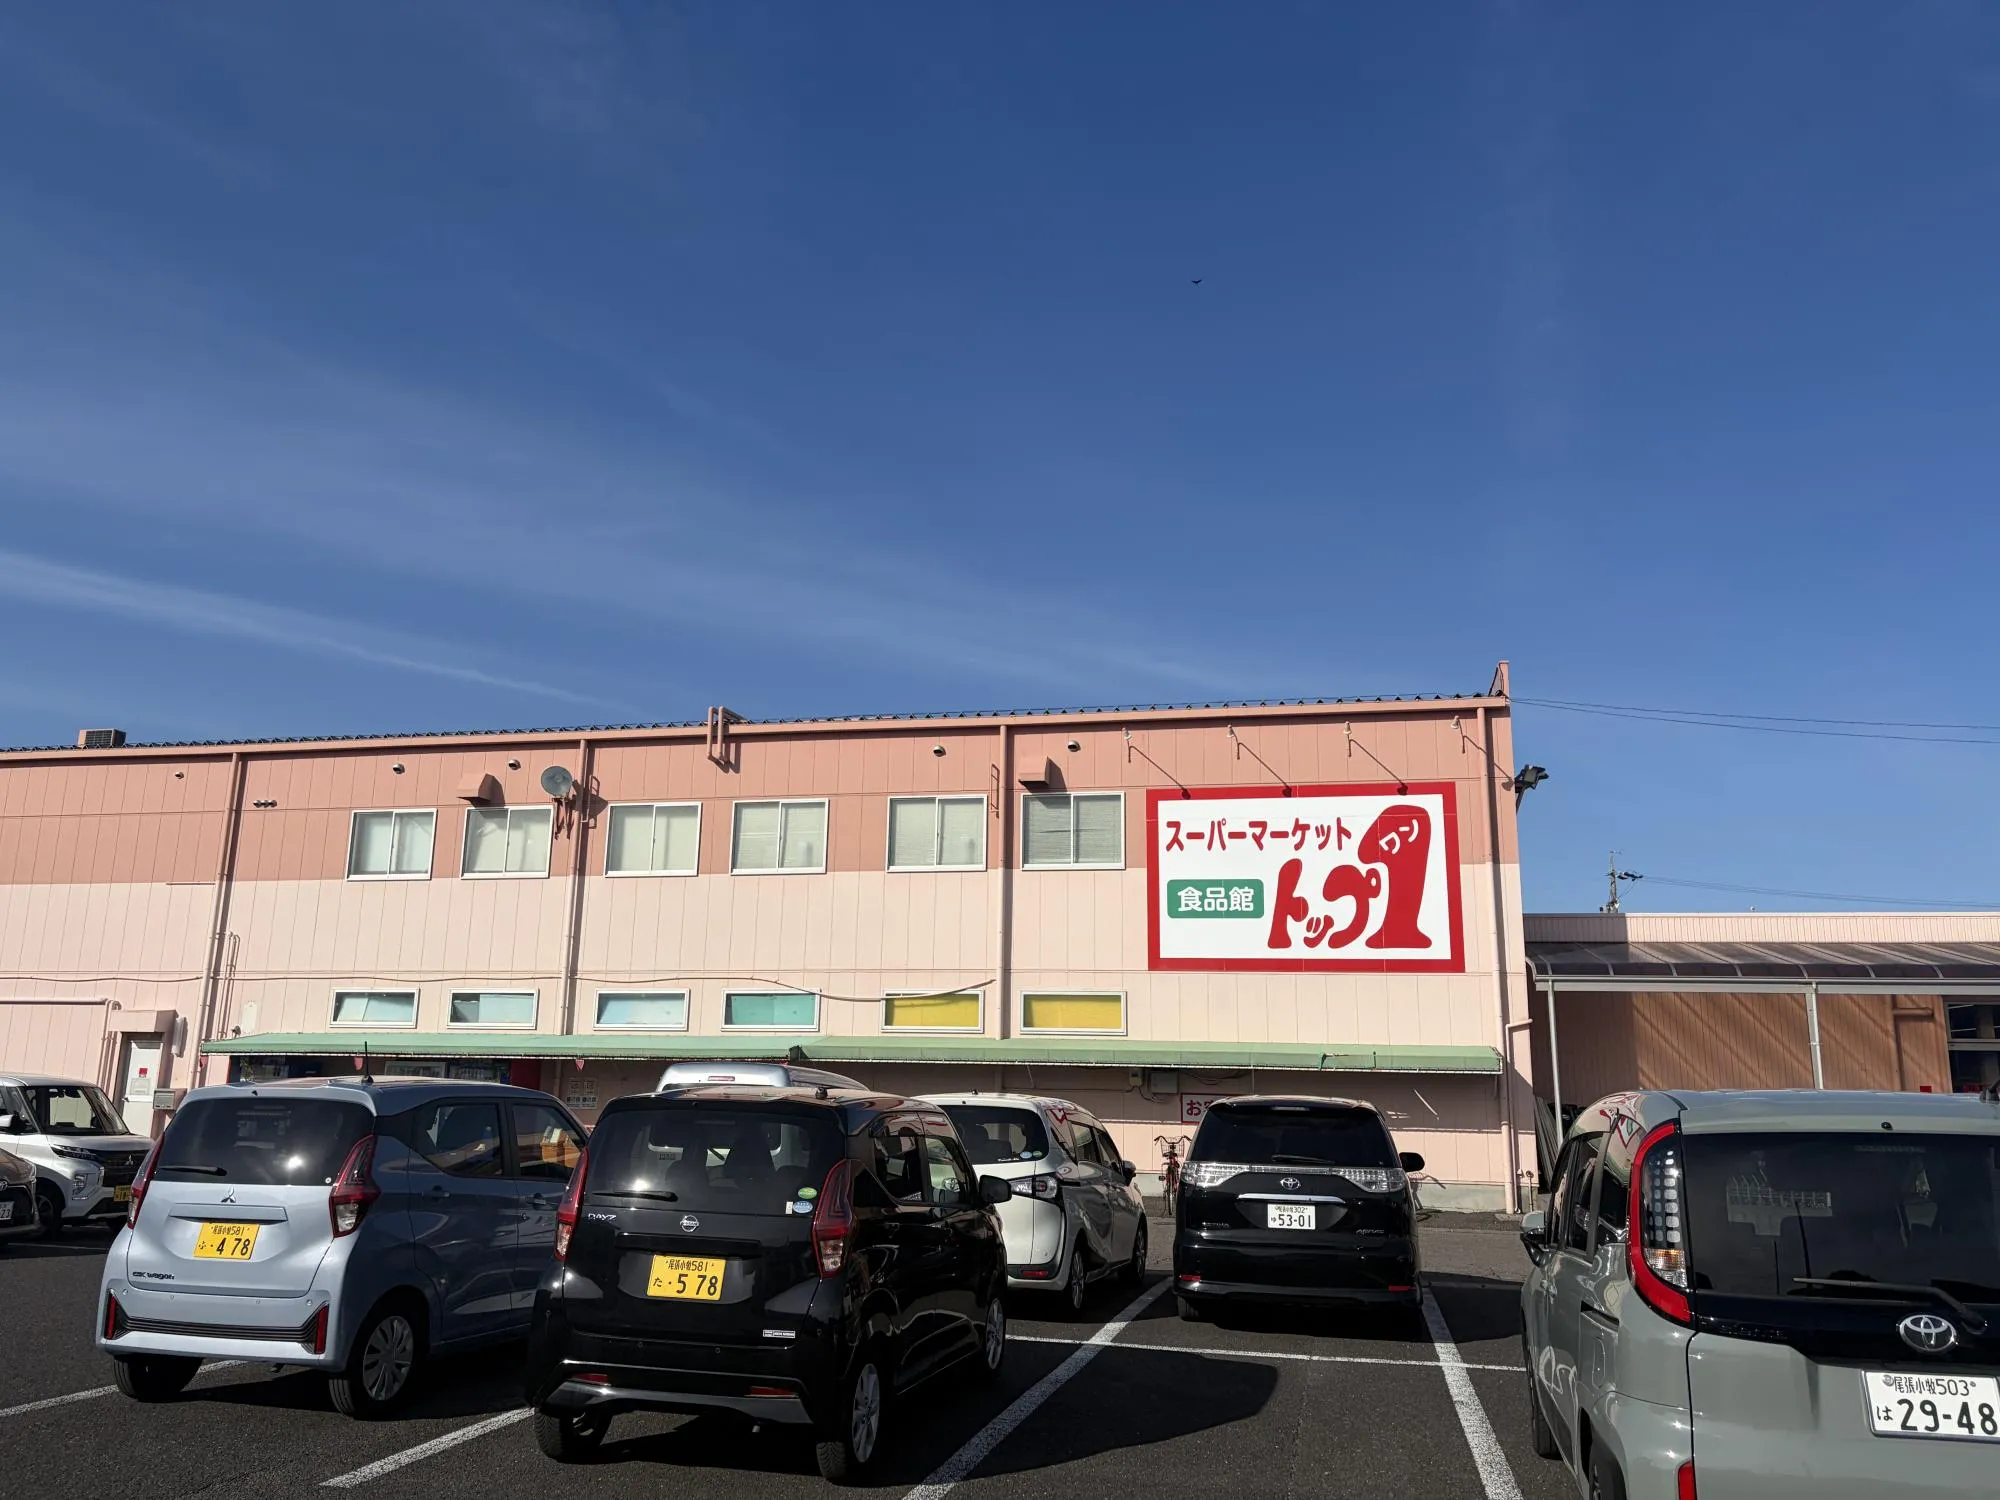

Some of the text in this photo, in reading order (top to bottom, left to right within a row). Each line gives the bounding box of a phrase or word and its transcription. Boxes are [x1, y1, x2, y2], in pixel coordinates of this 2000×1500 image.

[1166, 817, 1352, 851] スーパーマーケット
[1379, 818, 1419, 855] ワン
[1177, 886, 1255, 913] 食品館
[588, 1213, 617, 1221] DAYZ
[1278, 1214, 1311, 1228] 53-01
[147, 1272, 175, 1280] wagon
[652, 1277, 663, 1288] た
[1876, 1398, 1998, 1436] は 29-48
